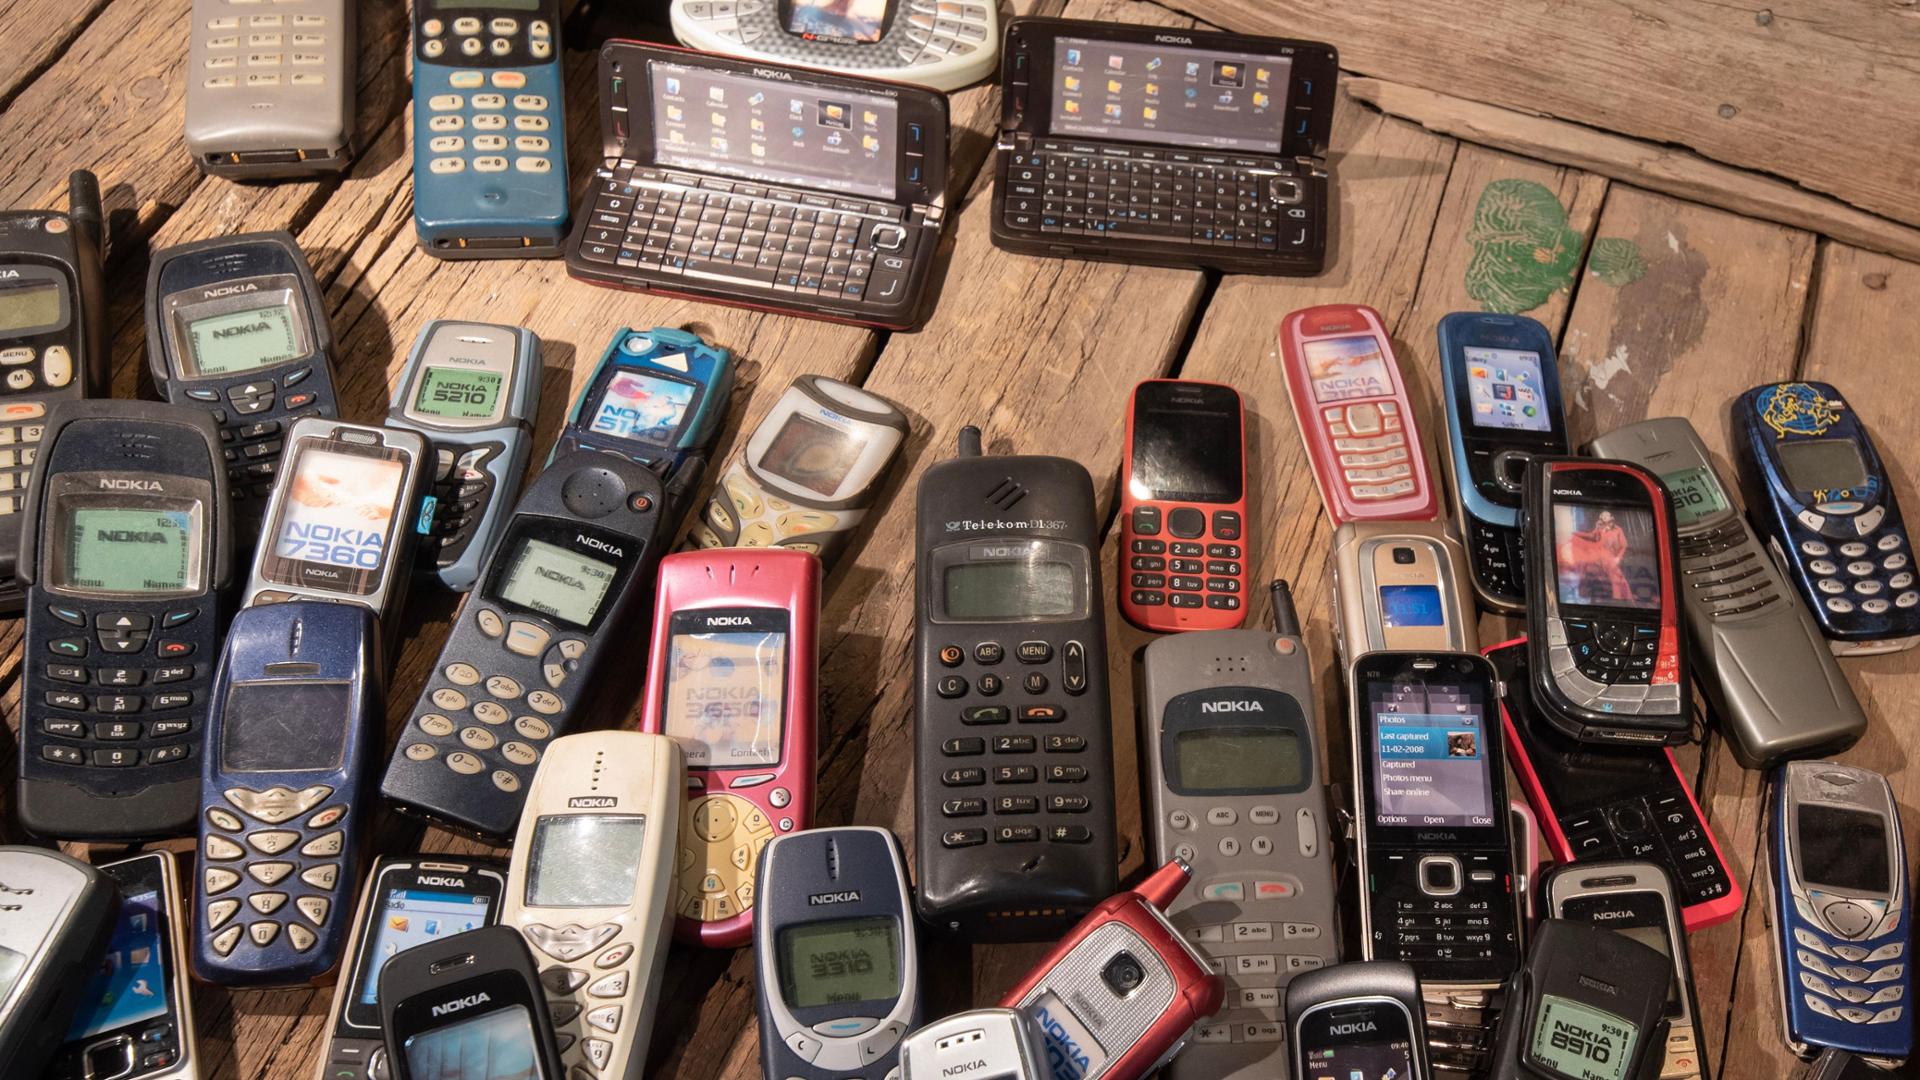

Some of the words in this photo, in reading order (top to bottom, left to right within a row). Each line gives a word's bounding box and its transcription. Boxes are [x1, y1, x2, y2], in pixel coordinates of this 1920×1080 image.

[1155, 34, 1192, 45] NOKIA
[753, 68, 792, 80] NOKIA
[204, 283, 258, 299] NOKIA
[213, 322, 272, 339] NOKIA
[449, 356, 486, 366] NOKIA
[437, 382, 488, 393] NOKIA
[1321, 376, 1380, 390] NOKIA
[433, 390, 486, 405] 5210
[100, 478, 164, 492] NOKIA
[97, 529, 168, 544] NOKIA
[286, 521, 384, 547] NOKIA
[576, 534, 624, 558] NOKIA
[284, 538, 381, 568] 7360
[305, 568, 339, 579] NOKIA
[535, 566, 586, 592] NOKIA
[530, 599, 560, 616] Menu
[707, 616, 752, 626] NOKIA
[980, 648, 998, 656] ABC
[1022, 646, 1046, 655] MENU
[948, 680, 957, 691] C
[984, 679, 993, 689] R
[1031, 676, 1041, 687] M
[687, 686, 759, 700] NOKIA
[686, 702, 760, 718] 3650
[1202, 701, 1264, 713] NOKIA
[1380, 716, 1406, 724] Photos
[1380, 732, 1396, 740] Last
[1397, 732, 1429, 742] captured
[1382, 746, 1425, 754] 11-02-2008
[1382, 760, 1416, 770] Captured
[1382, 774, 1410, 783] Photos
[1383, 788, 1405, 796] Share
[1406, 788, 1431, 797] online
[571, 798, 616, 808] NOKIA
[1256, 810, 1274, 818] MENU
[1378, 815, 1408, 824] Options
[1424, 816, 1445, 825] Open
[1472, 816, 1492, 825] Close
[1418, 832, 1457, 841] NOKIA
[417, 876, 465, 888] NOKIA
[810, 892, 860, 905] NOKIA
[1594, 910, 1635, 921] NOKIA
[810, 948, 871, 964] NOKIA
[811, 958, 874, 979] 3310
[1578, 976, 1617, 995] NOKIA
[432, 992, 491, 1017] NOKIA
[1073, 992, 1104, 1027] NOKIA
[1330, 1022, 1377, 1036] NOKIA
[1554, 1020, 1612, 1049] NOKIA
[1602, 1023, 1622, 1037] 9:30
[1036, 1007, 1090, 1073] NOKIA
[1550, 1031, 1611, 1065] 8910
[1310, 1060, 1328, 1069] Menu
[1534, 1052, 1559, 1069] Menu
[942, 1059, 988, 1078] NOKIA
